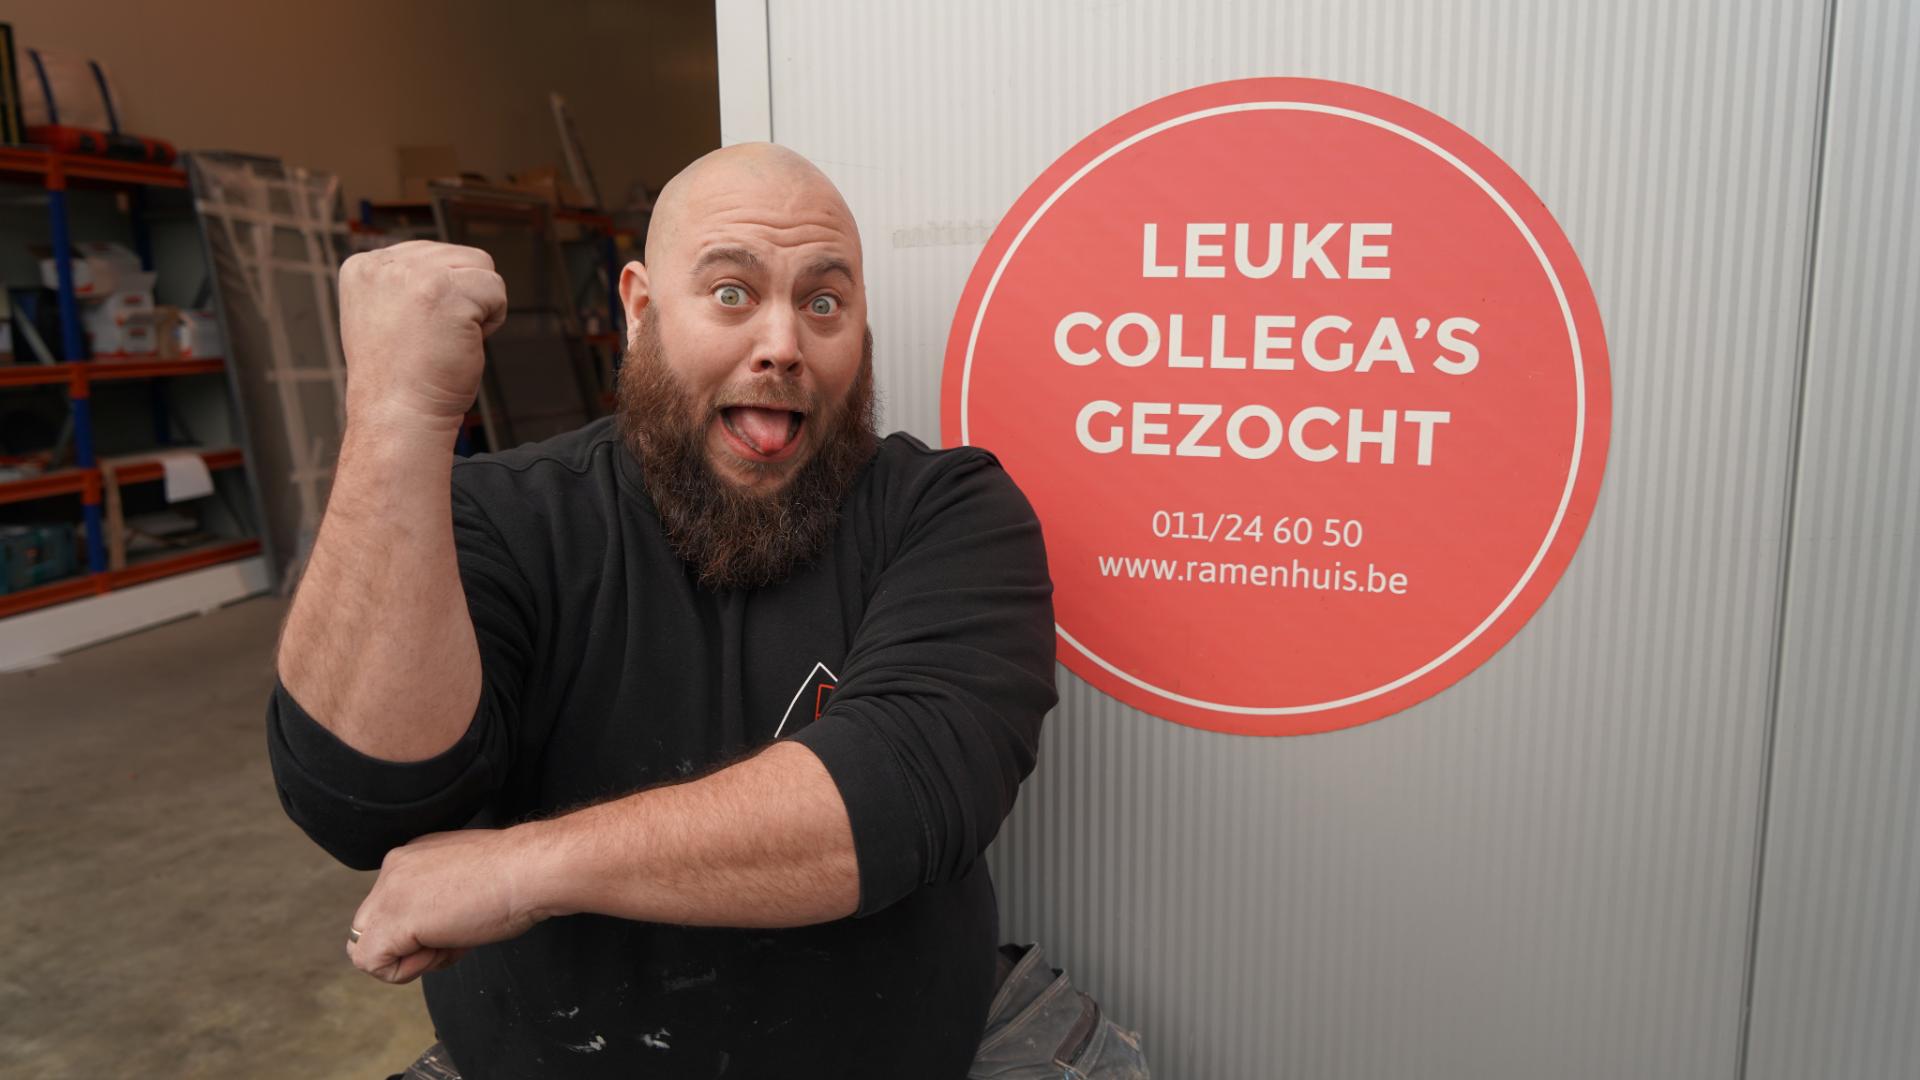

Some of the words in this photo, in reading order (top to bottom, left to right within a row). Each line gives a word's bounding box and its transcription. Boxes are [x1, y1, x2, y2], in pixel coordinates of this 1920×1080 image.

[1143, 222, 1393, 280] LEUKE
[1054, 311, 1481, 376] COLLEGA’S
[1075, 399, 1451, 467] GEZOCHT
[1151, 509, 1264, 543] 011/24
[1273, 516, 1313, 545] 60
[1322, 518, 1363, 548] 50
[1098, 556, 1409, 595] www.ramenhuis.be
